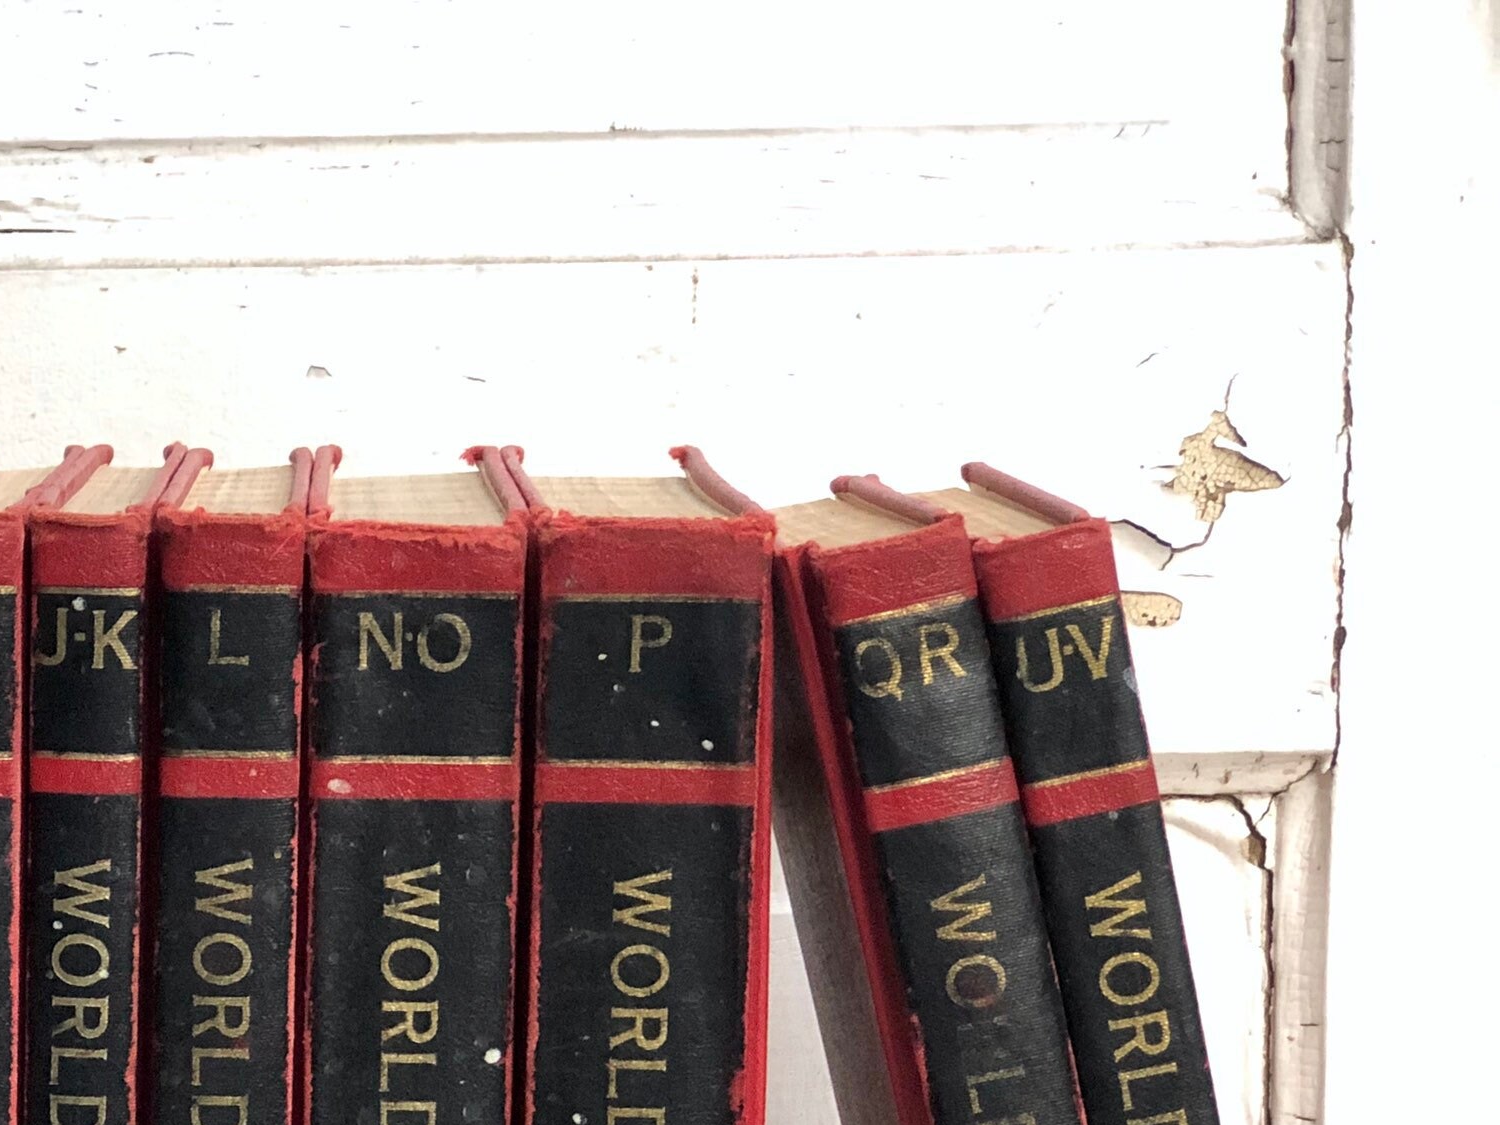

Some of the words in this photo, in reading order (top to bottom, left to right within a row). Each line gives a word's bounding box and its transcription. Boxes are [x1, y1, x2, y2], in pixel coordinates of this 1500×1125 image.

[206, 608, 250, 667] L
[626, 613, 673, 674] P
[917, 621, 969, 687] R
